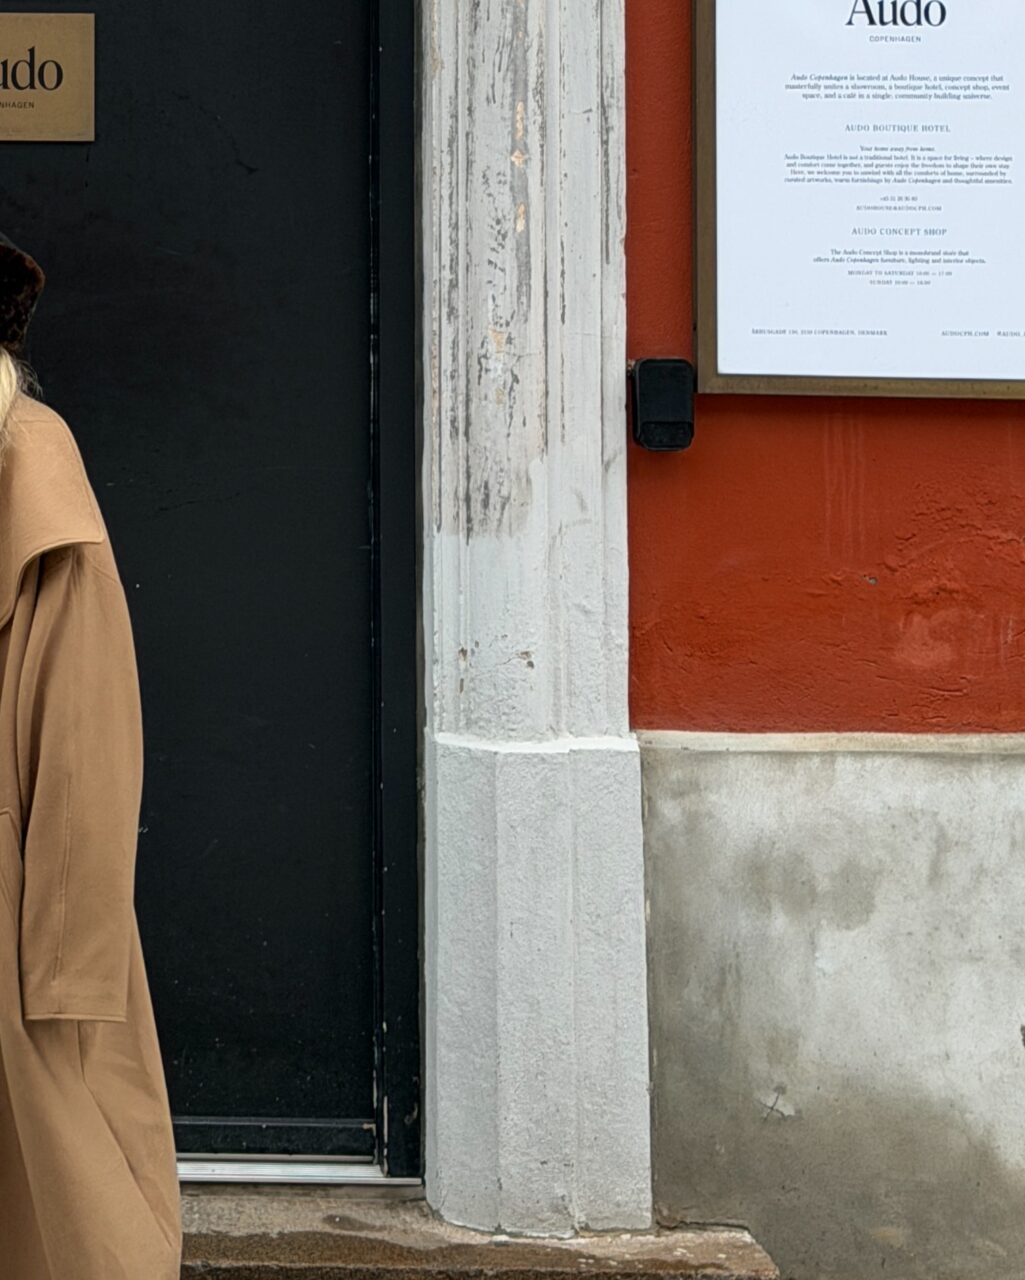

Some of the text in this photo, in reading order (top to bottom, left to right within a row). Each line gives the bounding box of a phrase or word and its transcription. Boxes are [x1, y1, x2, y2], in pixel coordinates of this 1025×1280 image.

[809, 74, 848, 82] Copenhagen
[872, 124, 918, 132] BOUTIQUE
[924, 228, 947, 236] SHOP
